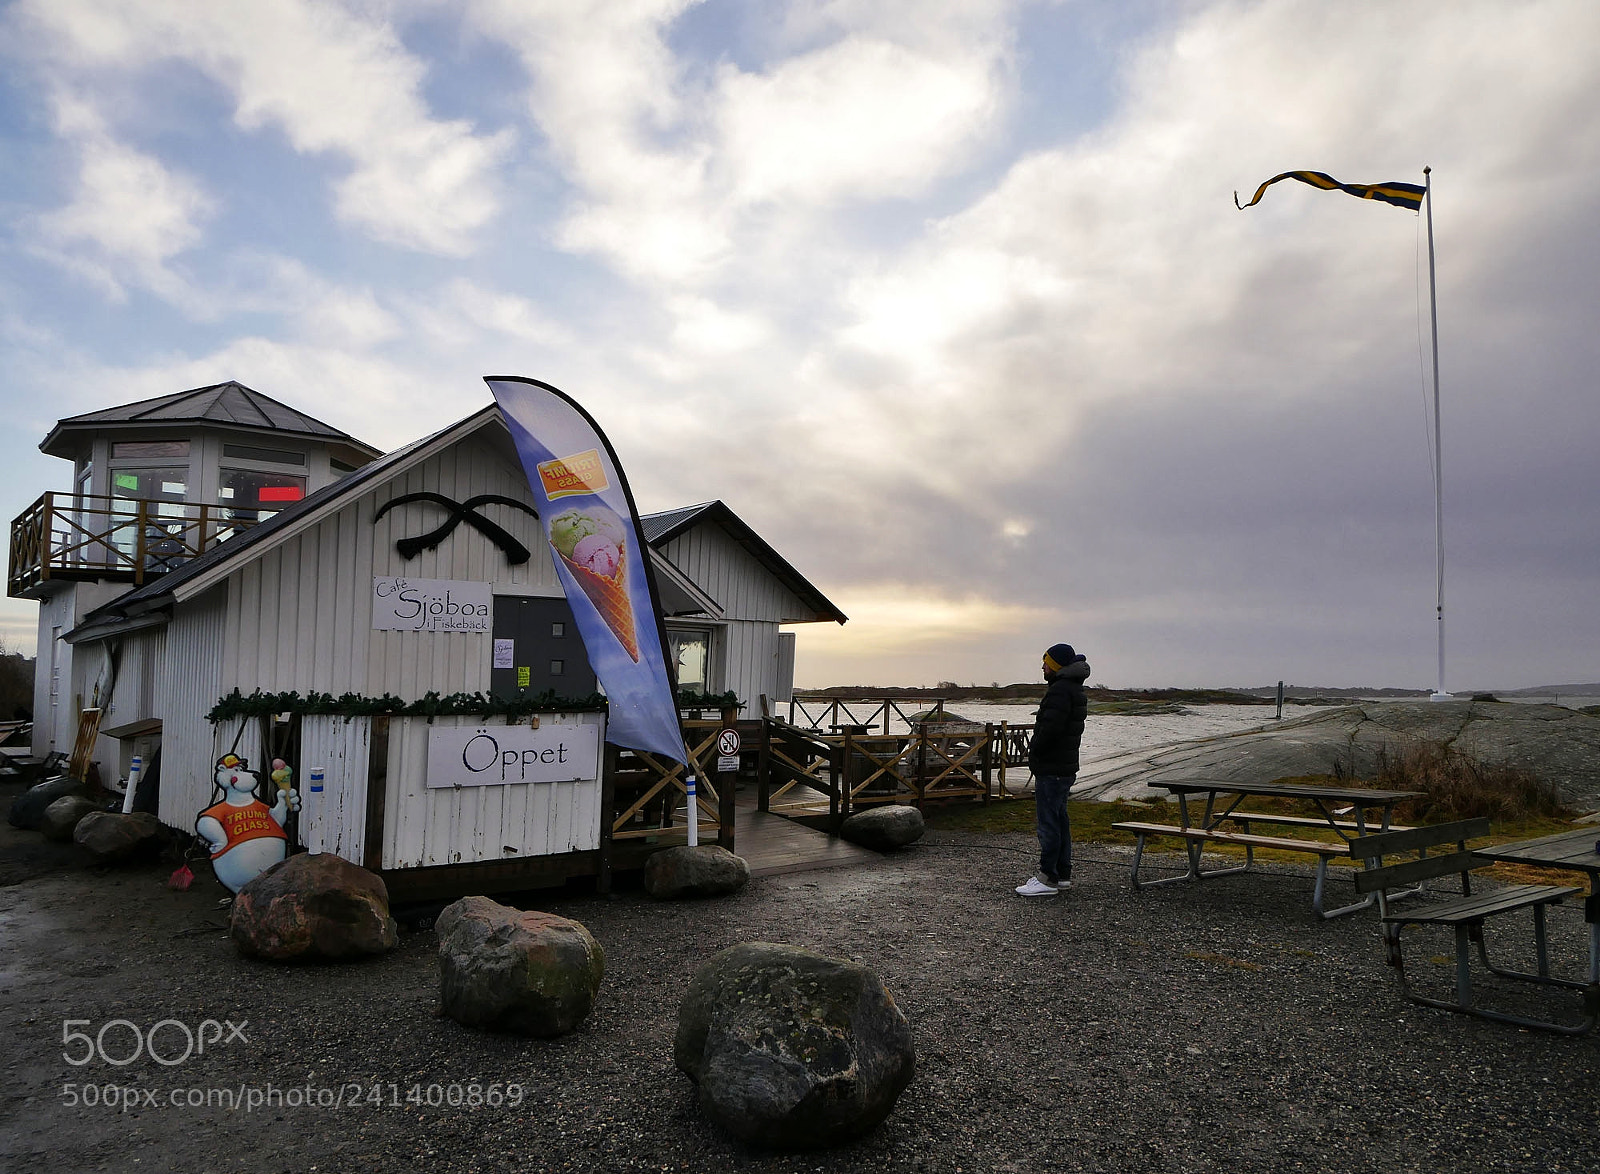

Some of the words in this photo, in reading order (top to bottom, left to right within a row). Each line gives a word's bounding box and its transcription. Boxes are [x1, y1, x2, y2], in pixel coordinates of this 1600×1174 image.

[376, 578, 408, 598] Café
[394, 588, 488, 630] Sjöboa
[432, 616, 488, 630] Fiskebäck
[462, 729, 568, 781] Öppet
[226, 810, 268, 825] TRIUMF
[233, 820, 270, 835] GLASS
